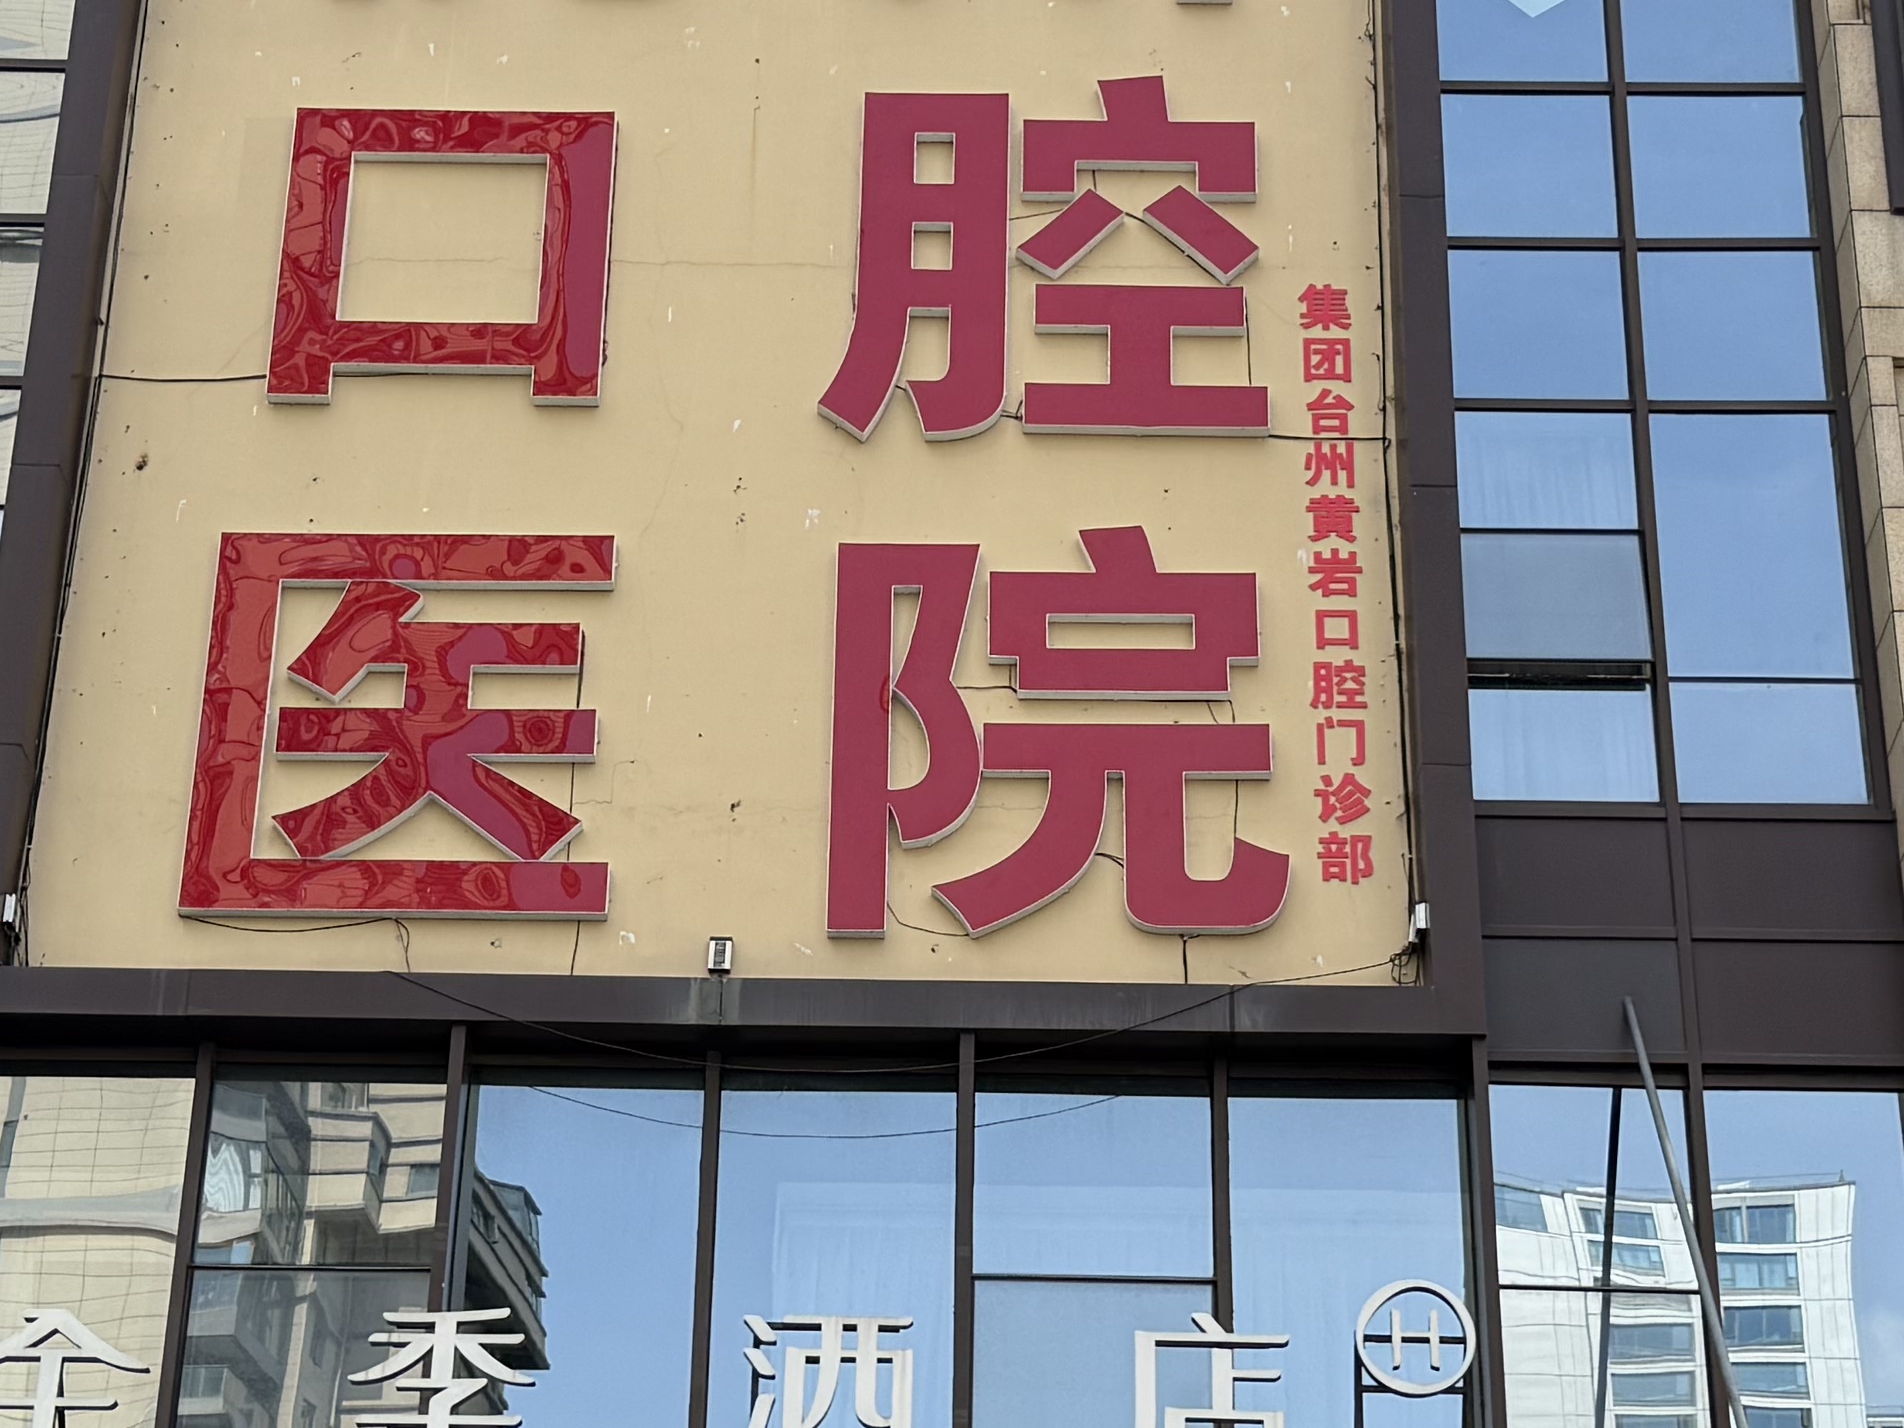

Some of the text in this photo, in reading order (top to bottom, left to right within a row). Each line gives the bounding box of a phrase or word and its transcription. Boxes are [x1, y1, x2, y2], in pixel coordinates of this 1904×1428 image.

[265, 75, 1270, 442] 口腔
[177, 524, 1290, 937] 医院
[1298, 283, 1374, 885] 集团台州黄岩口腔门诊部
